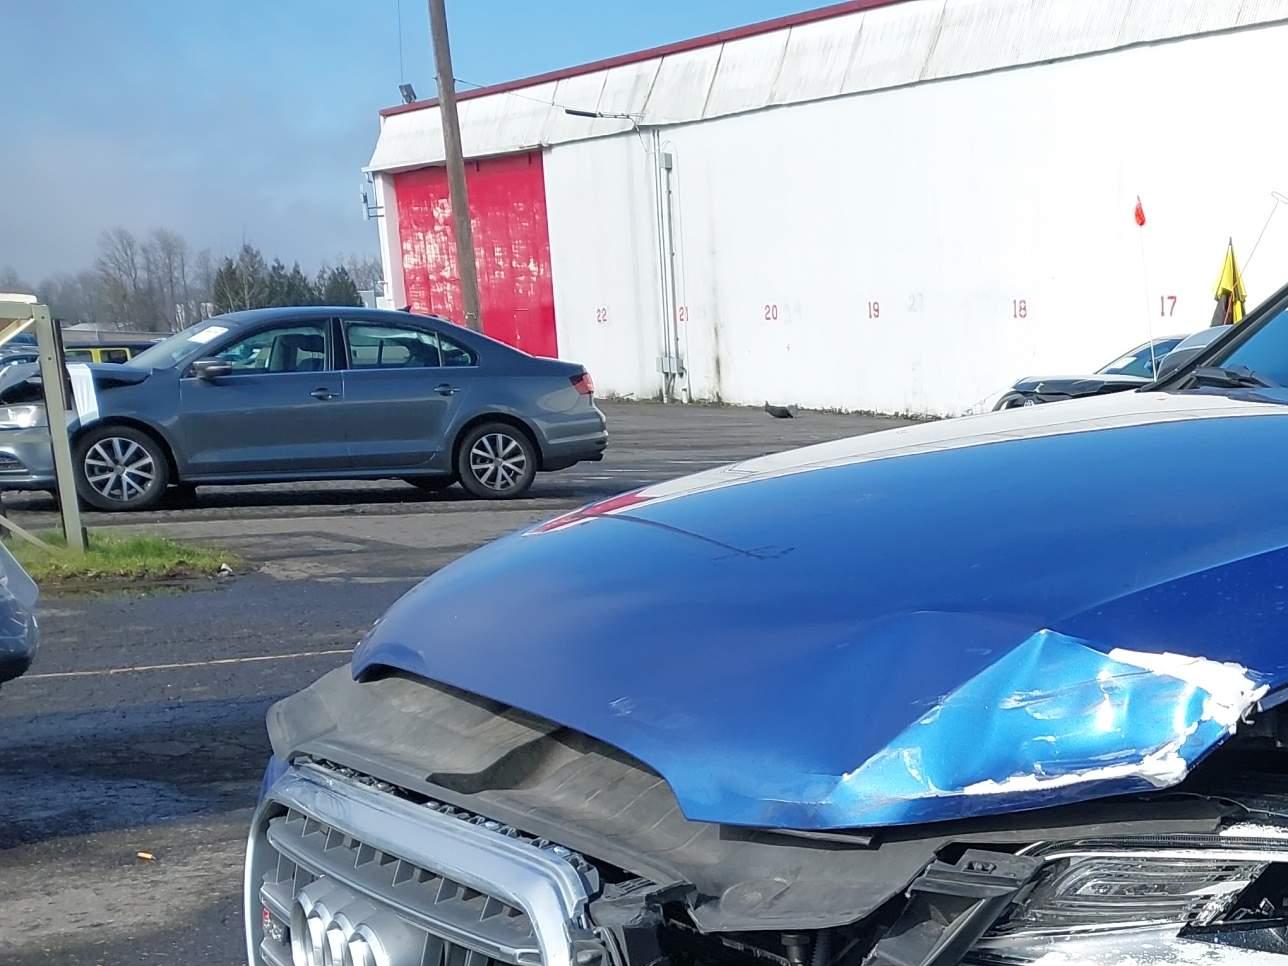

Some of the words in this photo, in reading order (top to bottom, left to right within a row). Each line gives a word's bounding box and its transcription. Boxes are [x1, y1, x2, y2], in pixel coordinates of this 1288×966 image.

[679, 306, 688, 321] 21
[764, 304, 778, 320] 20
[867, 301, 880, 319] 19
[1013, 299, 1027, 318] 18
[1160, 295, 1177, 317] 17
[596, 308, 607, 322] 22
